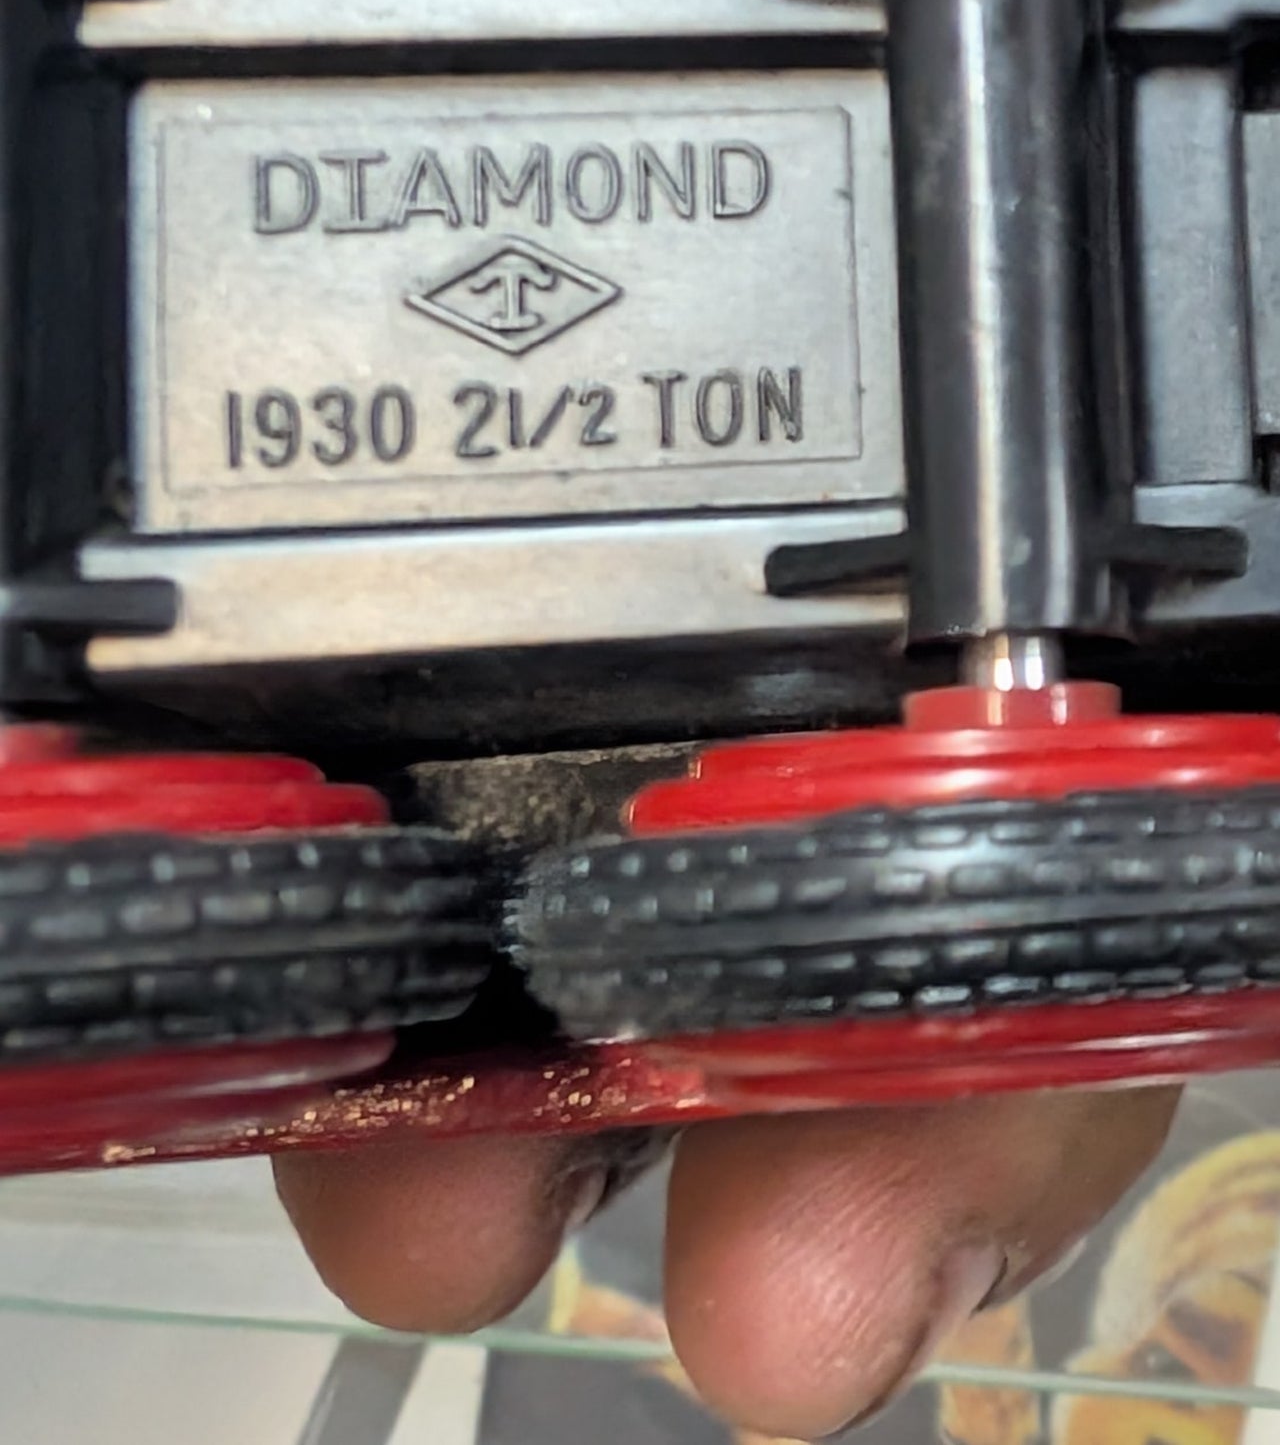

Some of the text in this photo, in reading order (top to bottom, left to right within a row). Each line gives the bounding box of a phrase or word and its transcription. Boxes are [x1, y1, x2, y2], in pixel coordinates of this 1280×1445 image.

[252, 138, 774, 236] DIAMOND
[224, 384, 416, 470] 1930
[641, 364, 804, 450] TON
